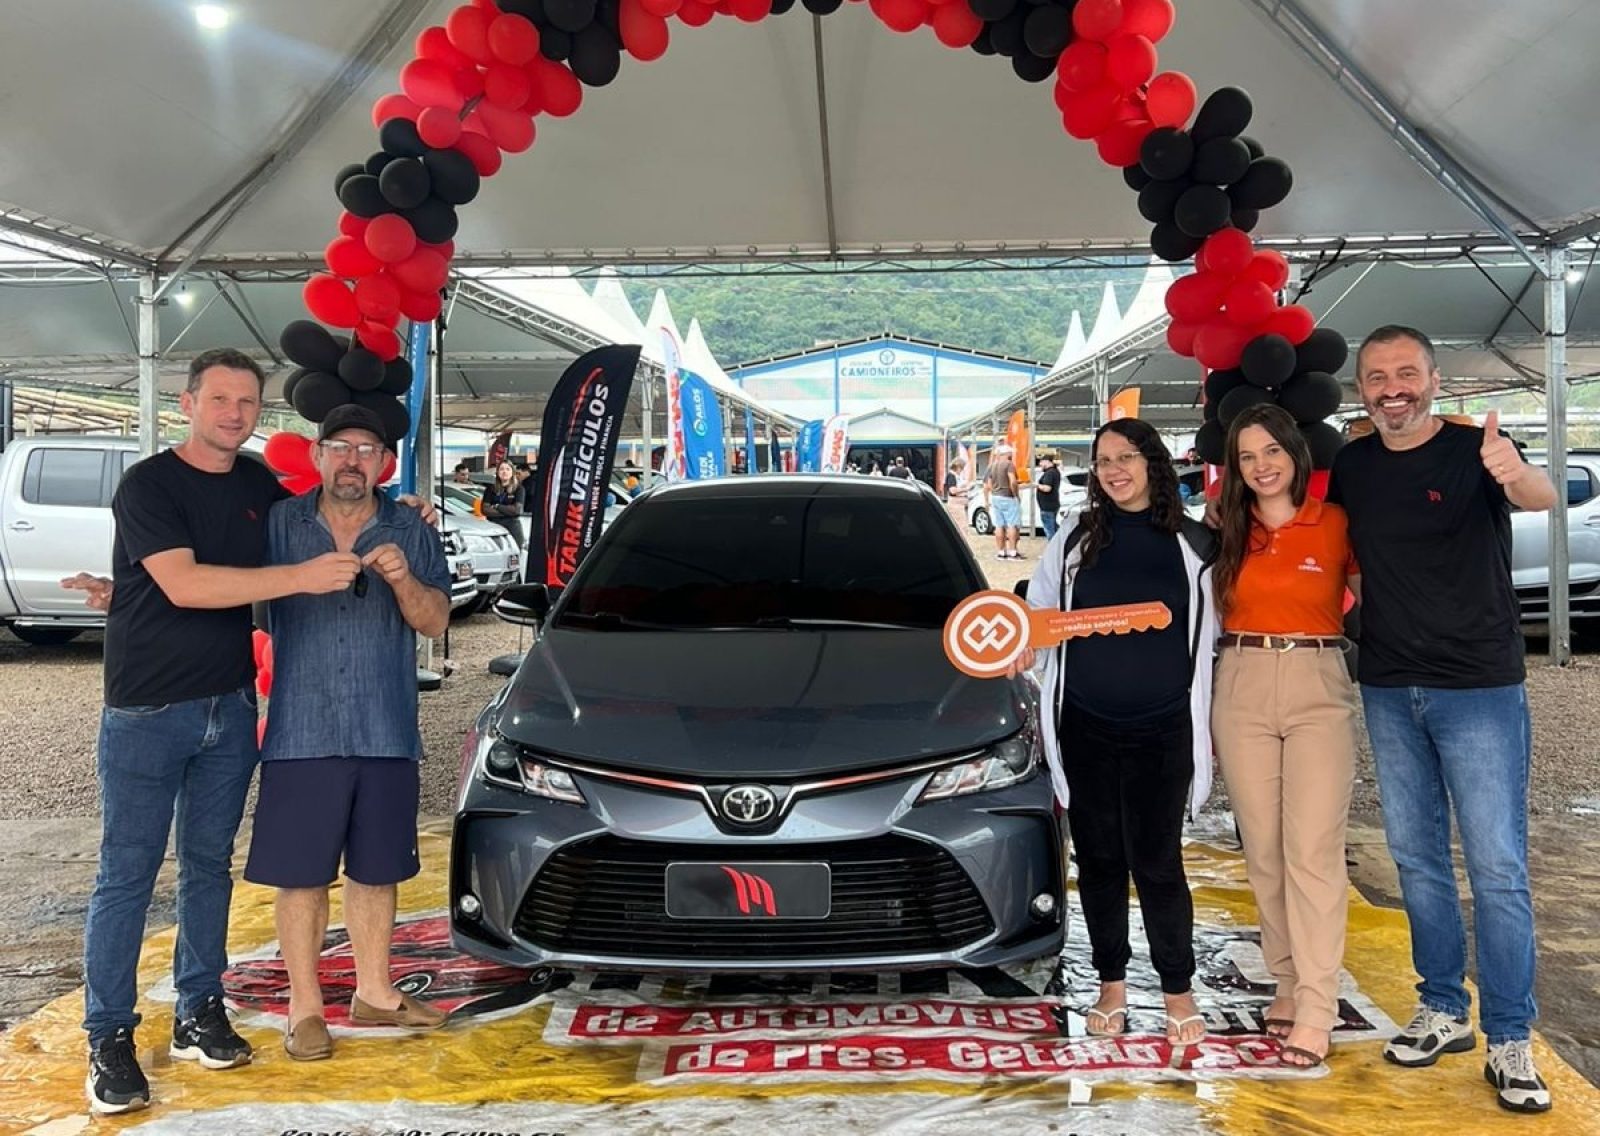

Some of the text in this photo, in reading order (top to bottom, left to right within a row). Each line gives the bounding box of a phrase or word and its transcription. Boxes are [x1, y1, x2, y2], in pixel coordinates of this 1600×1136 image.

[841, 367, 916, 376] CAMIONEIROS
[560, 384, 609, 572] TARIK VEÍCULOS
[586, 1009, 658, 1032] de
[677, 1044, 749, 1070] de
[773, 1043, 926, 1068] Pres.
